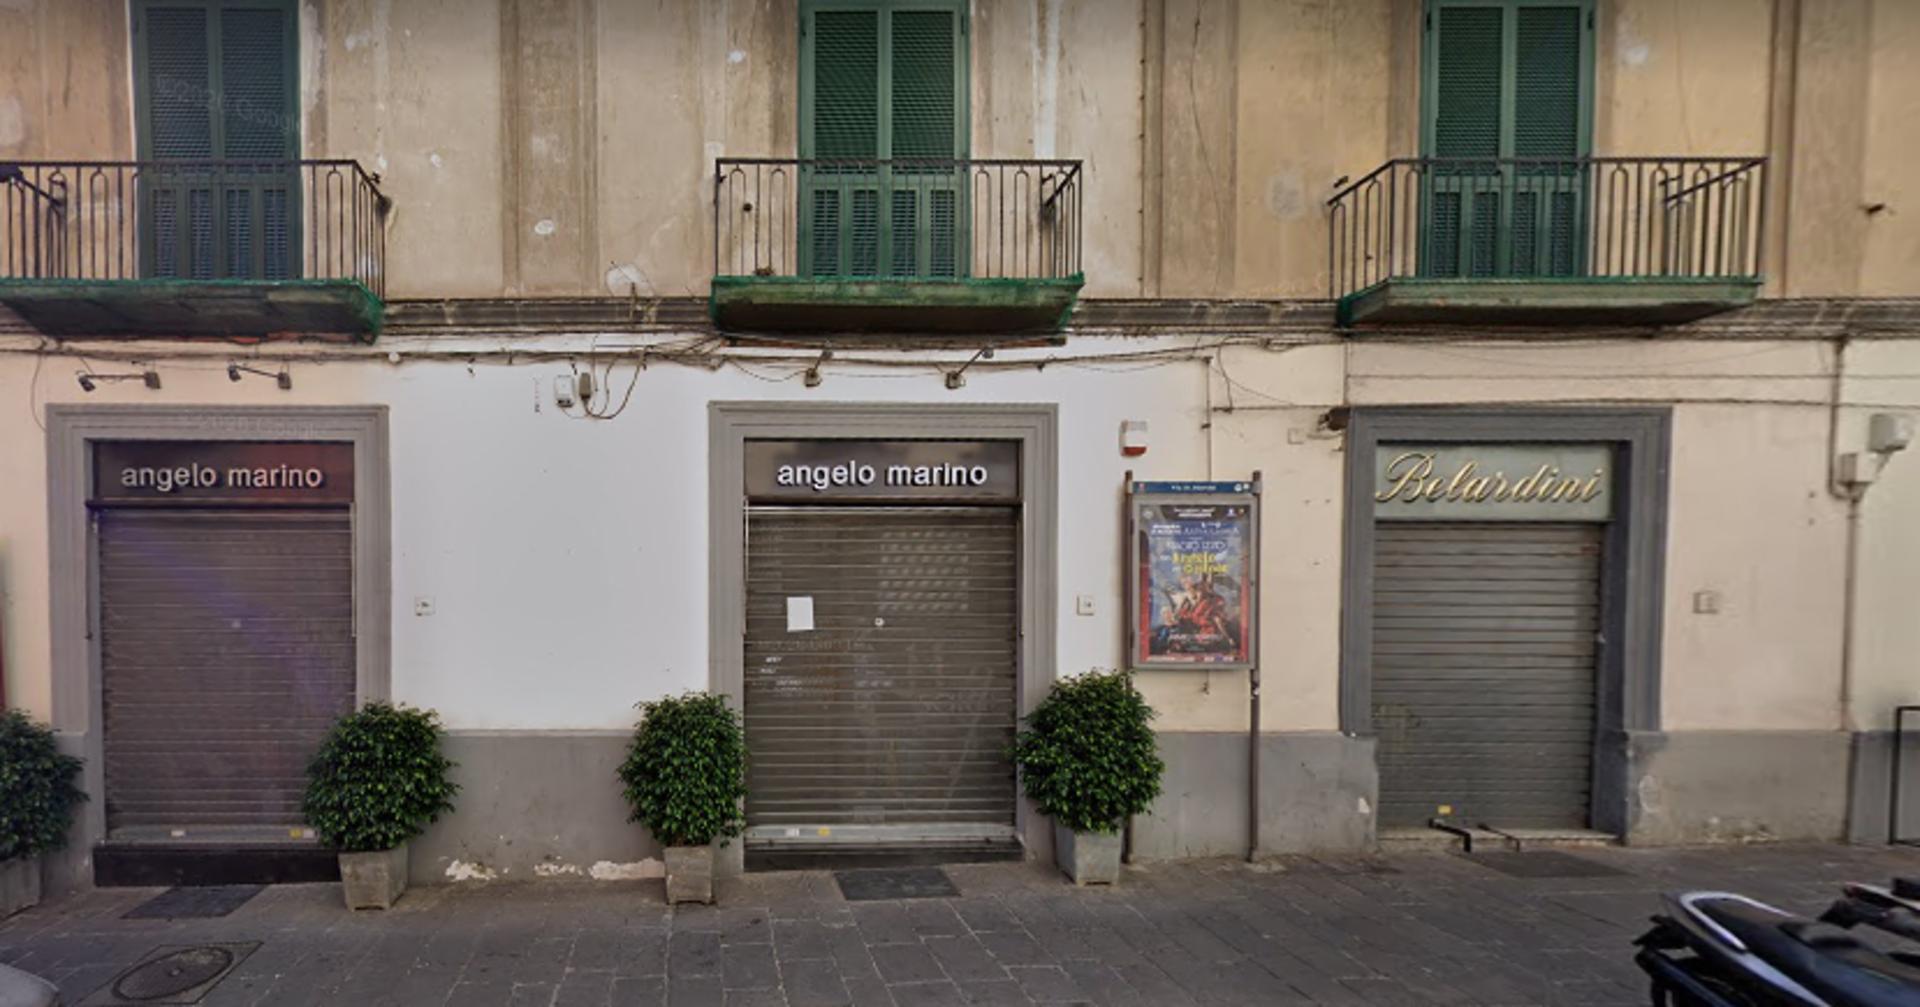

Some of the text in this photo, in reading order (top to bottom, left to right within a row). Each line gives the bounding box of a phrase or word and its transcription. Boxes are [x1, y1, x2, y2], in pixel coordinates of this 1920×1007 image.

[120, 462, 323, 492] angelo marino
[776, 459, 988, 491] angelo marino
[1374, 450, 1604, 504] Belardini
